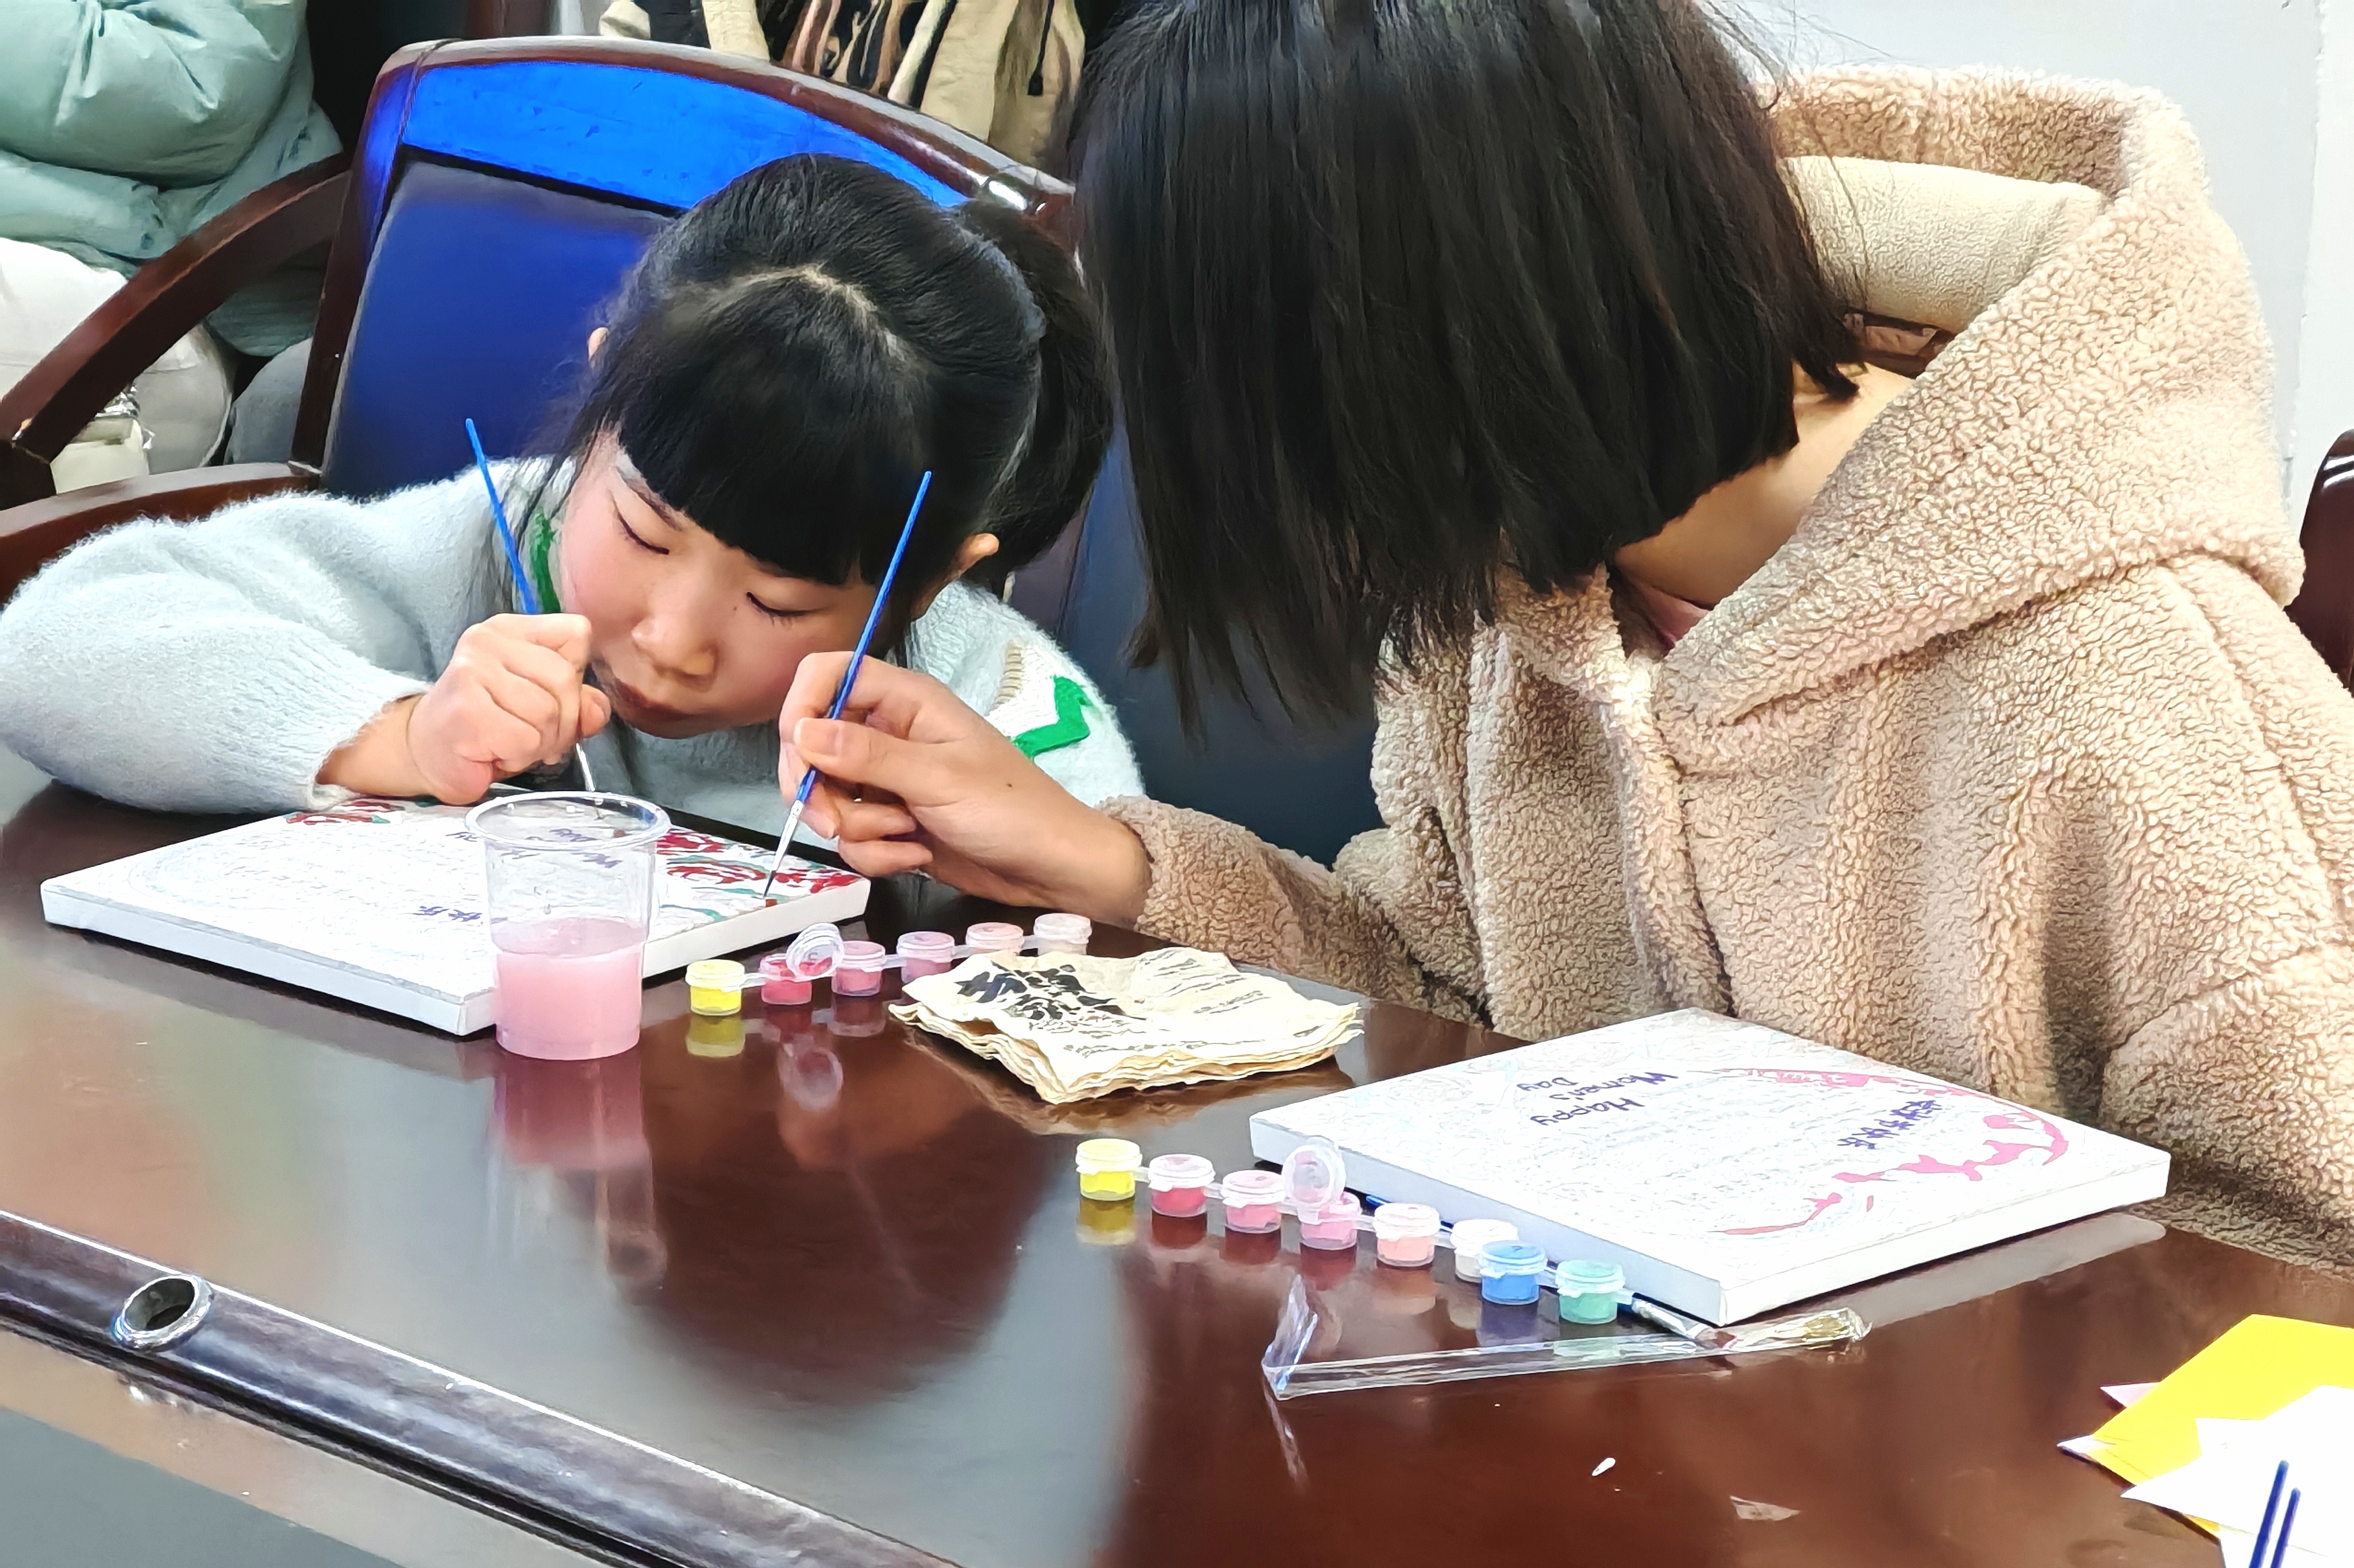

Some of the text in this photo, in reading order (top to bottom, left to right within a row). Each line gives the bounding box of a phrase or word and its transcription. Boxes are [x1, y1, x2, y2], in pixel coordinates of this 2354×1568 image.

[1517, 1077, 1578, 1091] Day
[1549, 1072, 1679, 1100] Women's
[1530, 1097, 1645, 1126] Happy
